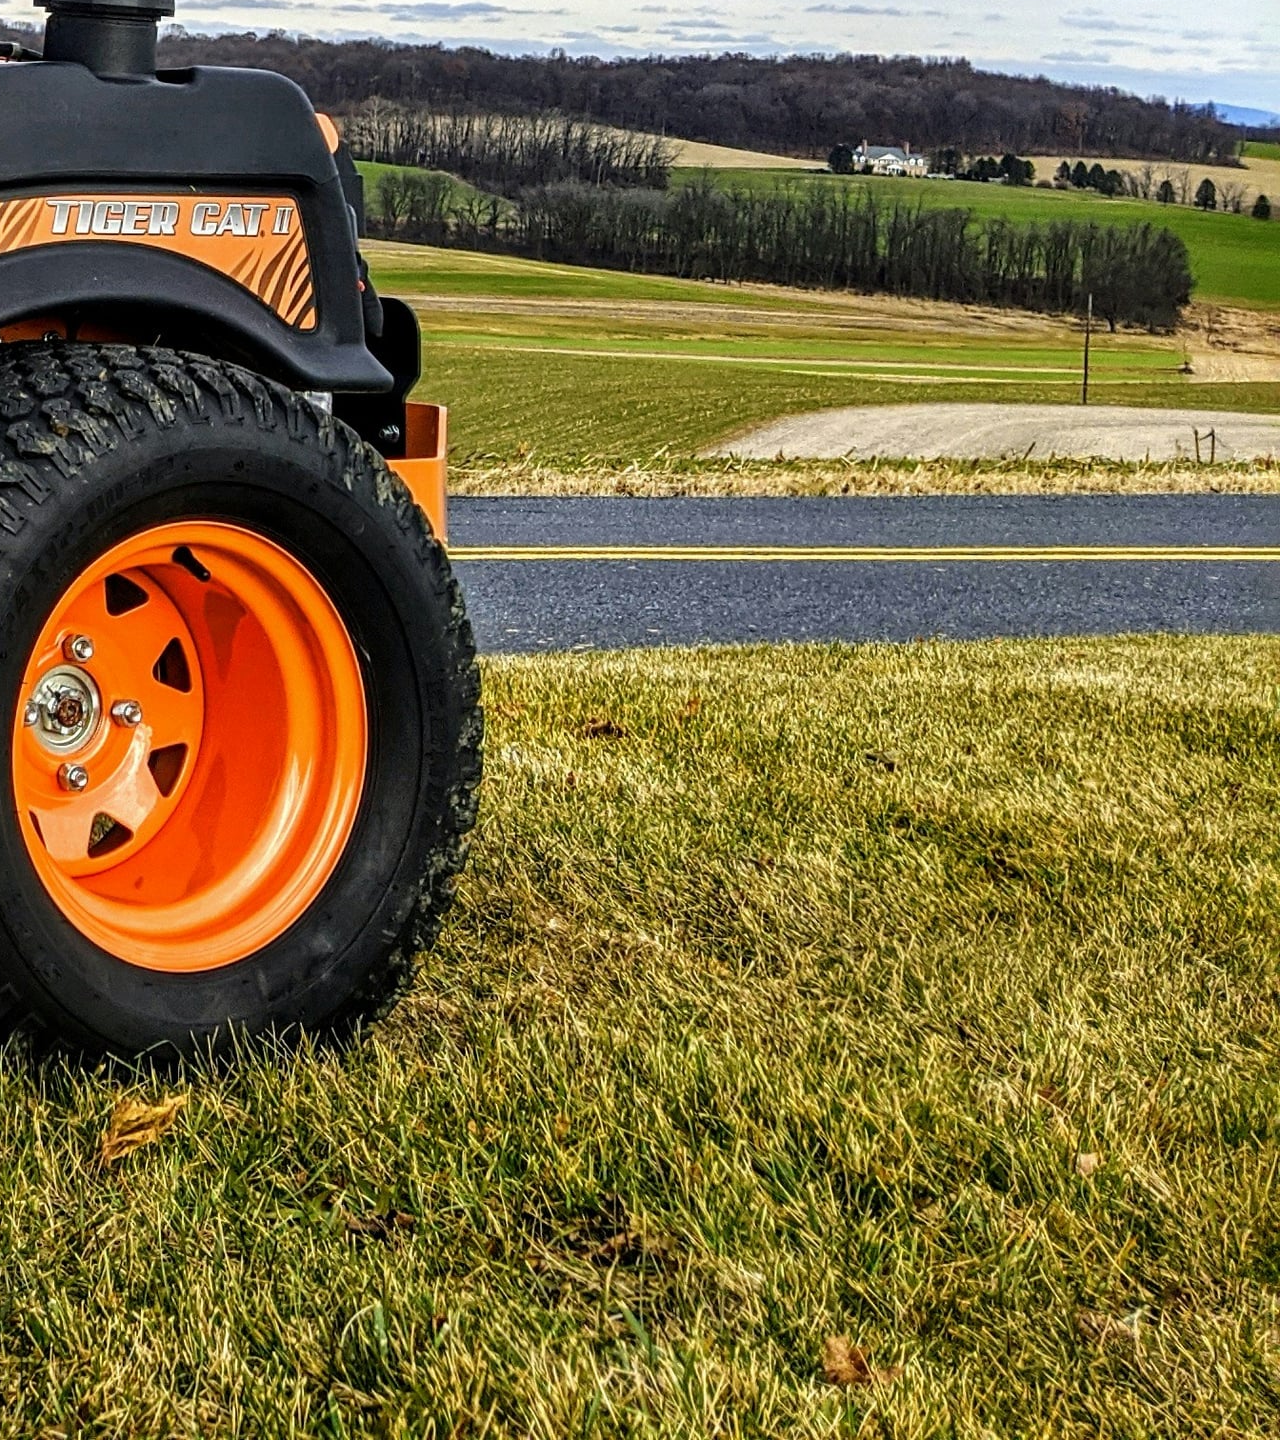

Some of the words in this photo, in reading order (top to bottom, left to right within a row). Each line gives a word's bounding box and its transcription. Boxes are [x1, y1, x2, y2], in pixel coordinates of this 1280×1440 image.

[46, 199, 180, 236] TIGER
[191, 202, 269, 238] CAT
[271, 206, 294, 236] II
